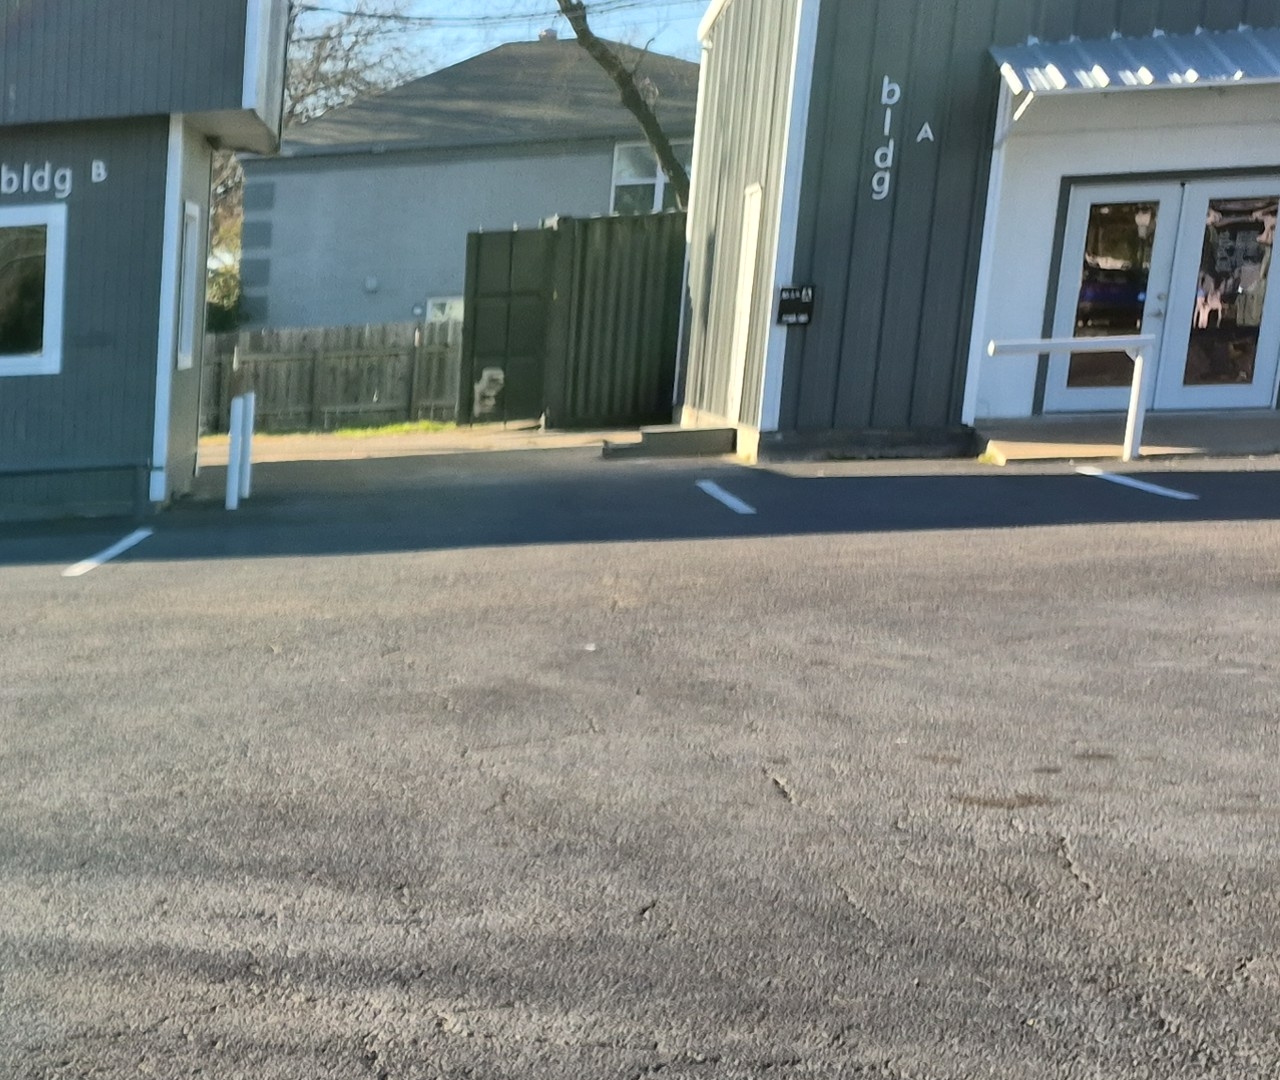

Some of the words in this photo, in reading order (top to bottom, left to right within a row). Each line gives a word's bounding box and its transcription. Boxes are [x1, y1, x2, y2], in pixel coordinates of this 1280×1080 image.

[871, 74, 901, 200] bldg
[916, 121, 935, 143] A
[0, 160, 73, 199] bldg
[91, 159, 108, 183] B
